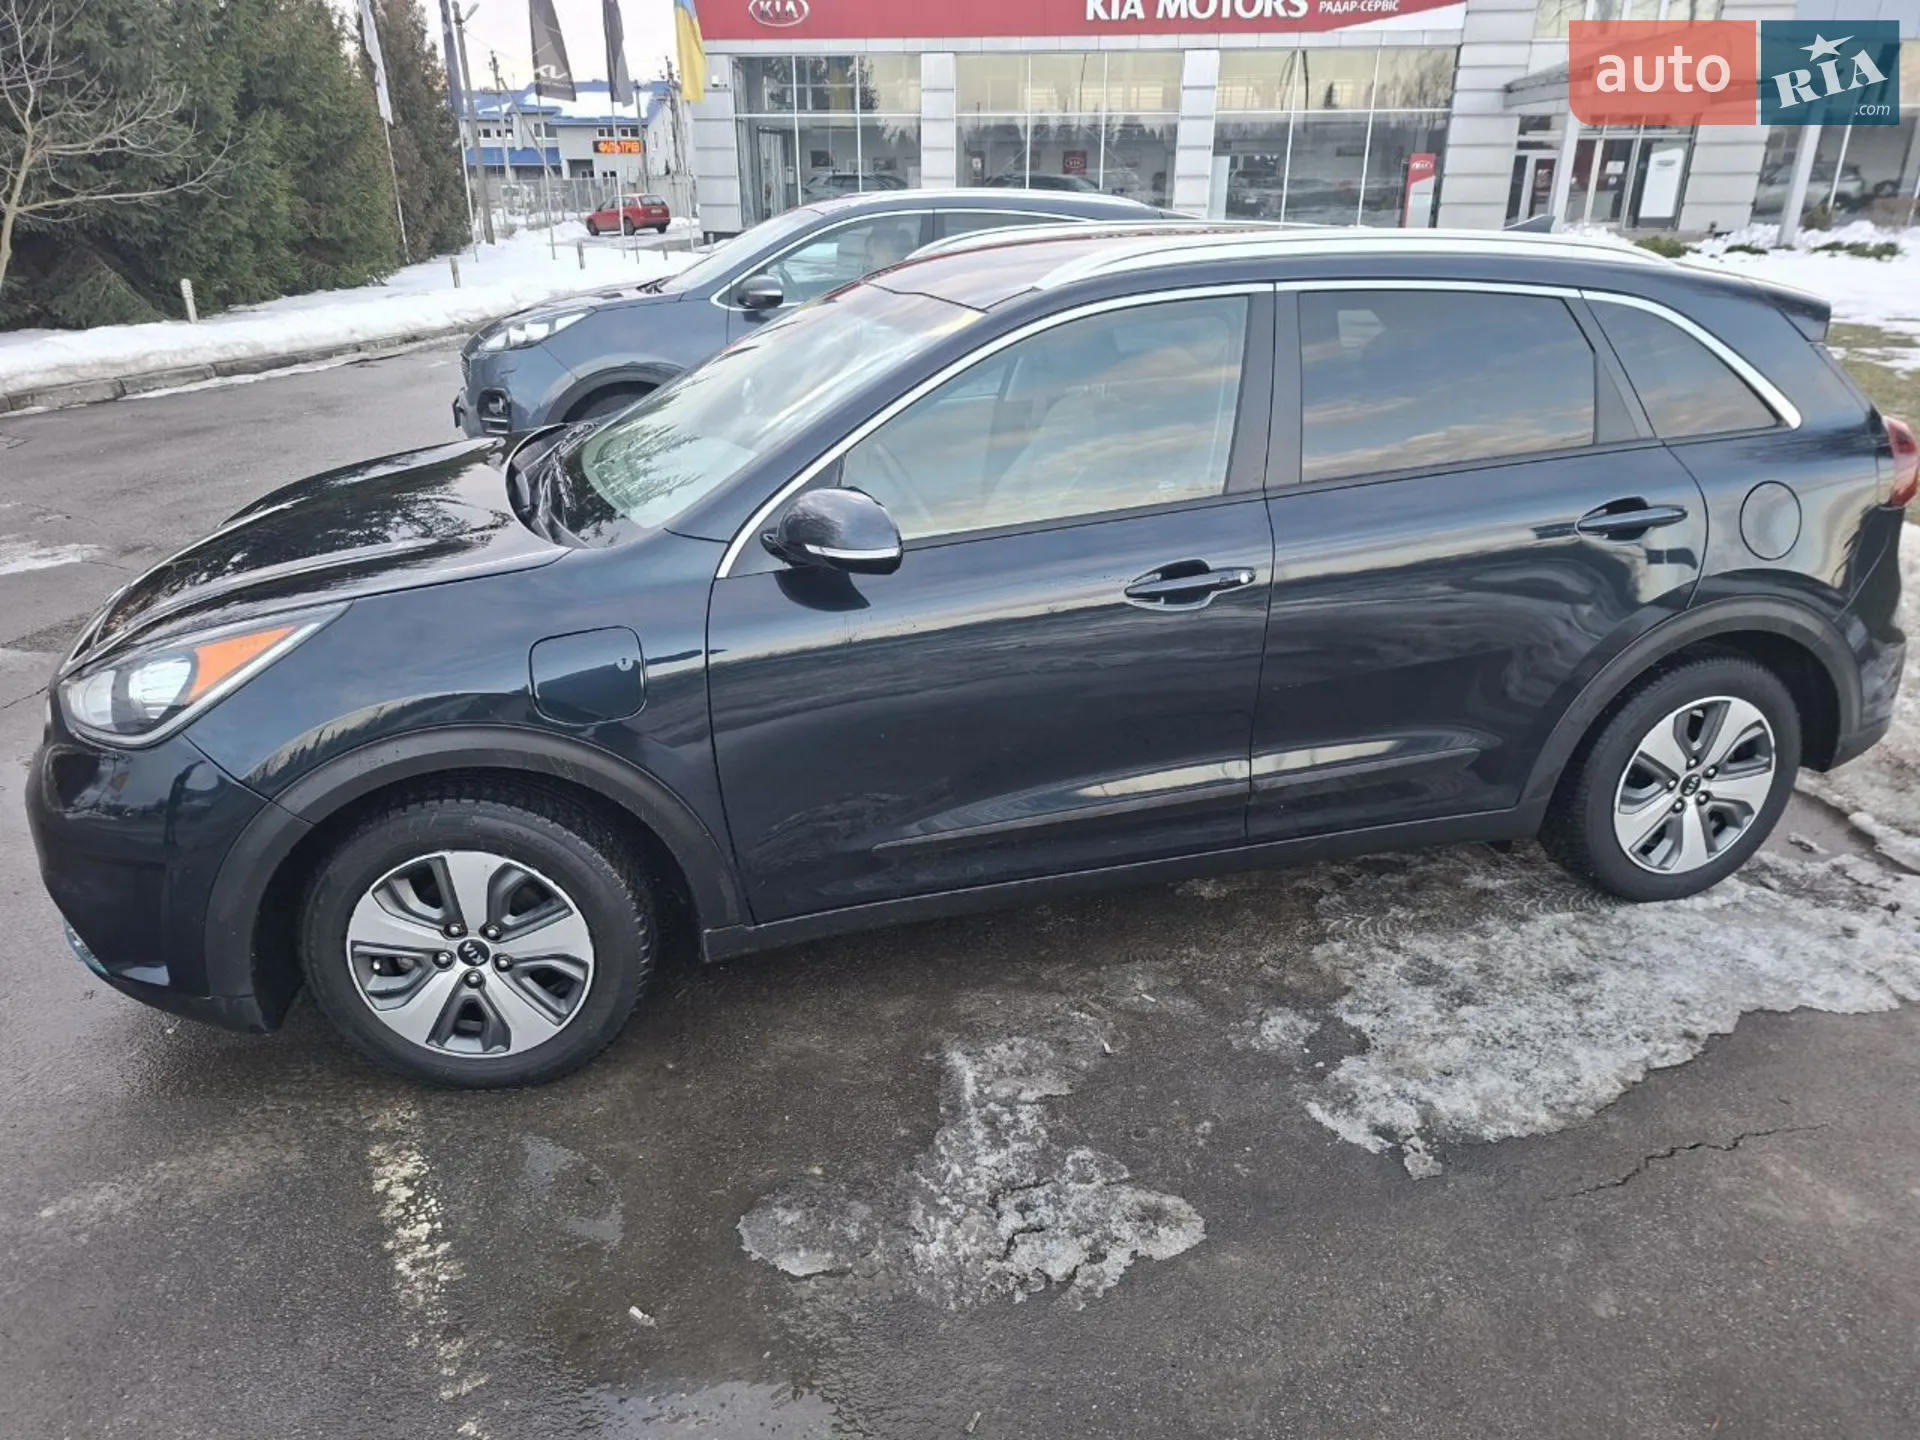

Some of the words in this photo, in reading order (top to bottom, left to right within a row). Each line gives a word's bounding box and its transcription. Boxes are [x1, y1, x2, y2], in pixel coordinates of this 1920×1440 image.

[758, 0, 799, 18] KIA
[1086, 0, 1145, 20] KIA
[1156, 0, 1308, 19] MOTORS
[1319, 0, 1399, 15] РАДАР-СЕРВІС
[462, 941, 486, 965] KIA
